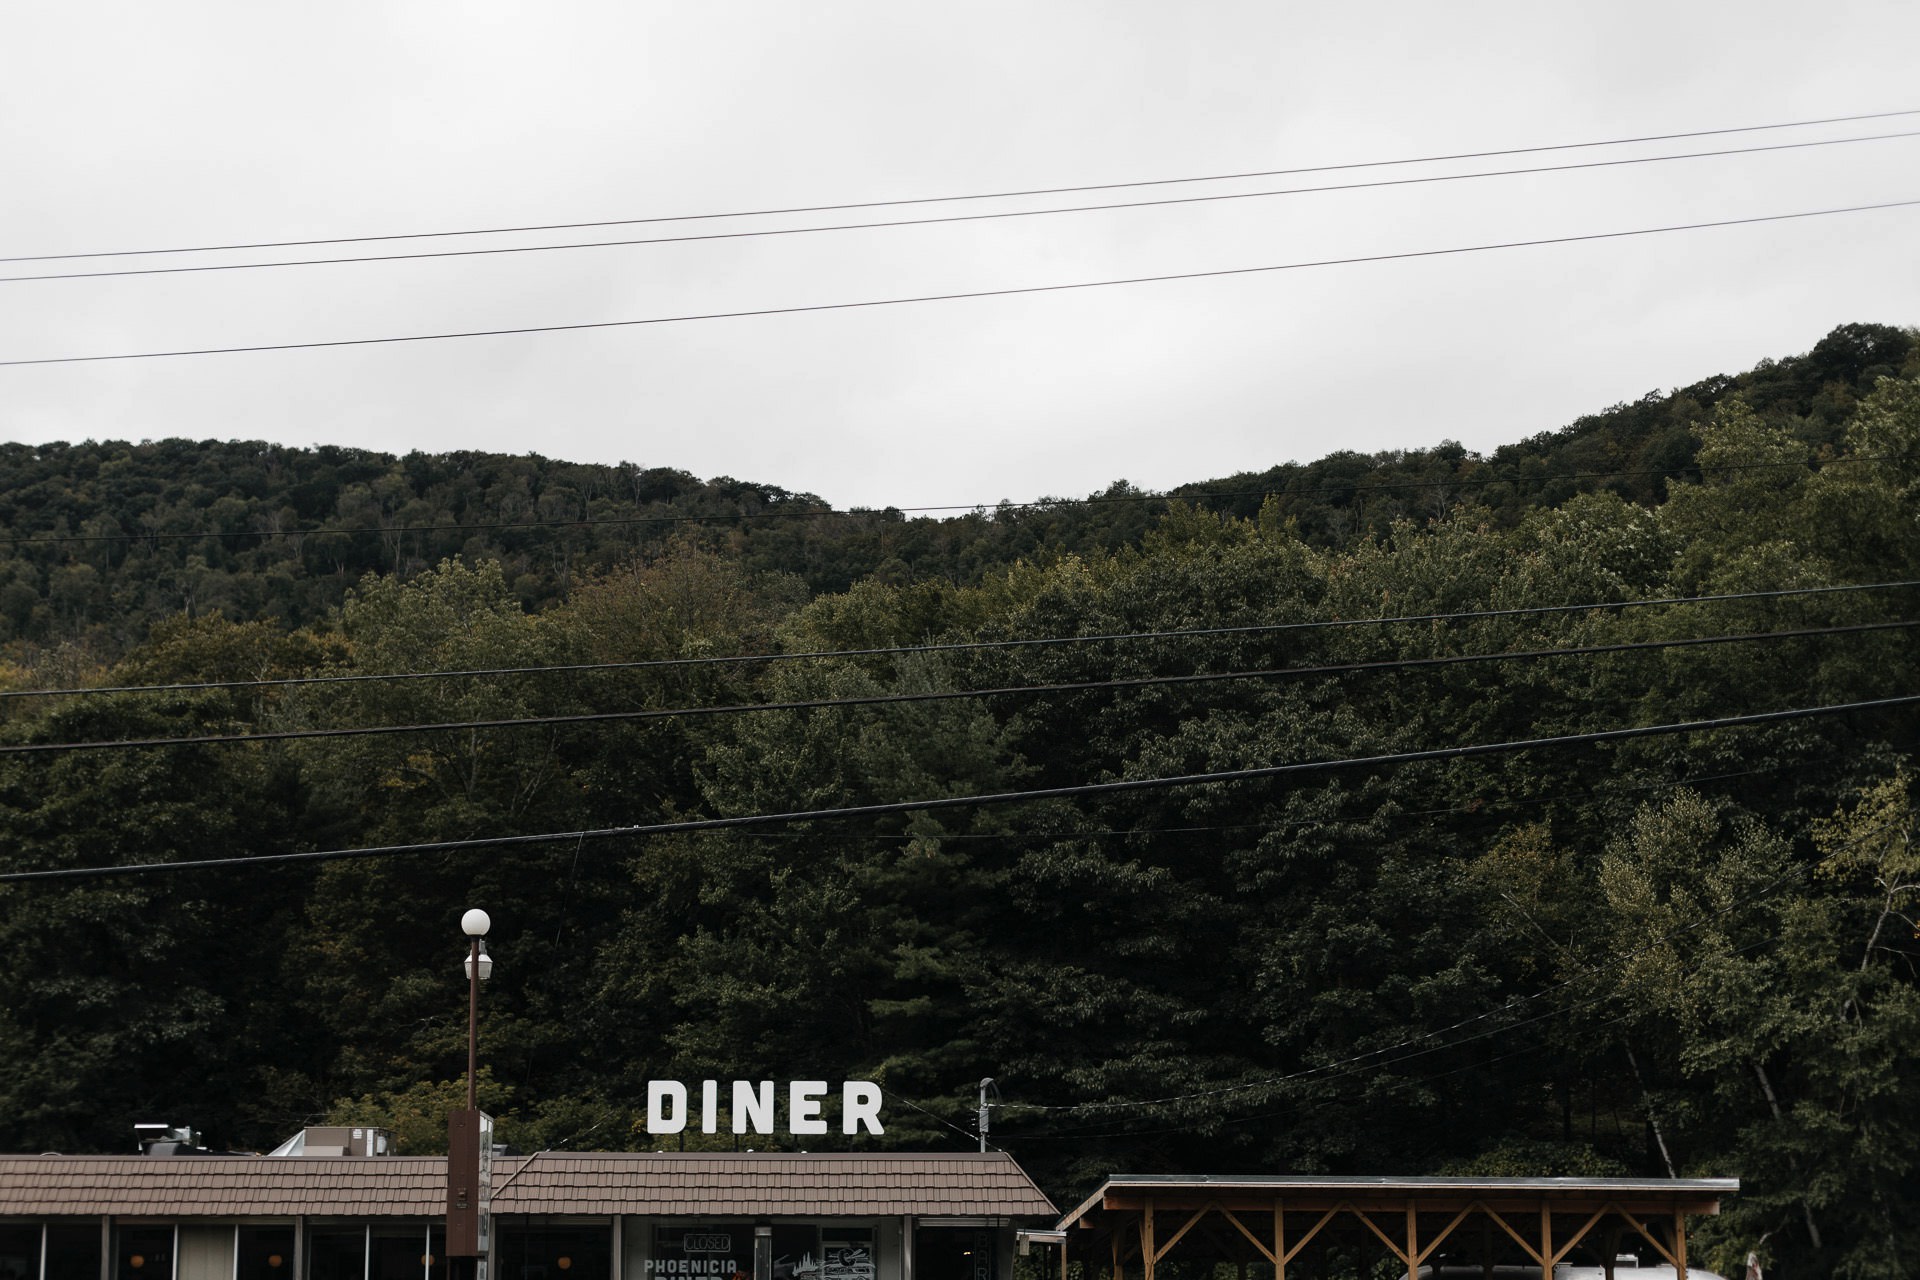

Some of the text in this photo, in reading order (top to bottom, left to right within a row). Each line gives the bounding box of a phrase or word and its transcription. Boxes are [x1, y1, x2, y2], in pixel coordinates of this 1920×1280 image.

[647, 1080, 885, 1135] DINER
[685, 1236, 729, 1250] CLOSED
[644, 1259, 737, 1274] PHOENICIA
